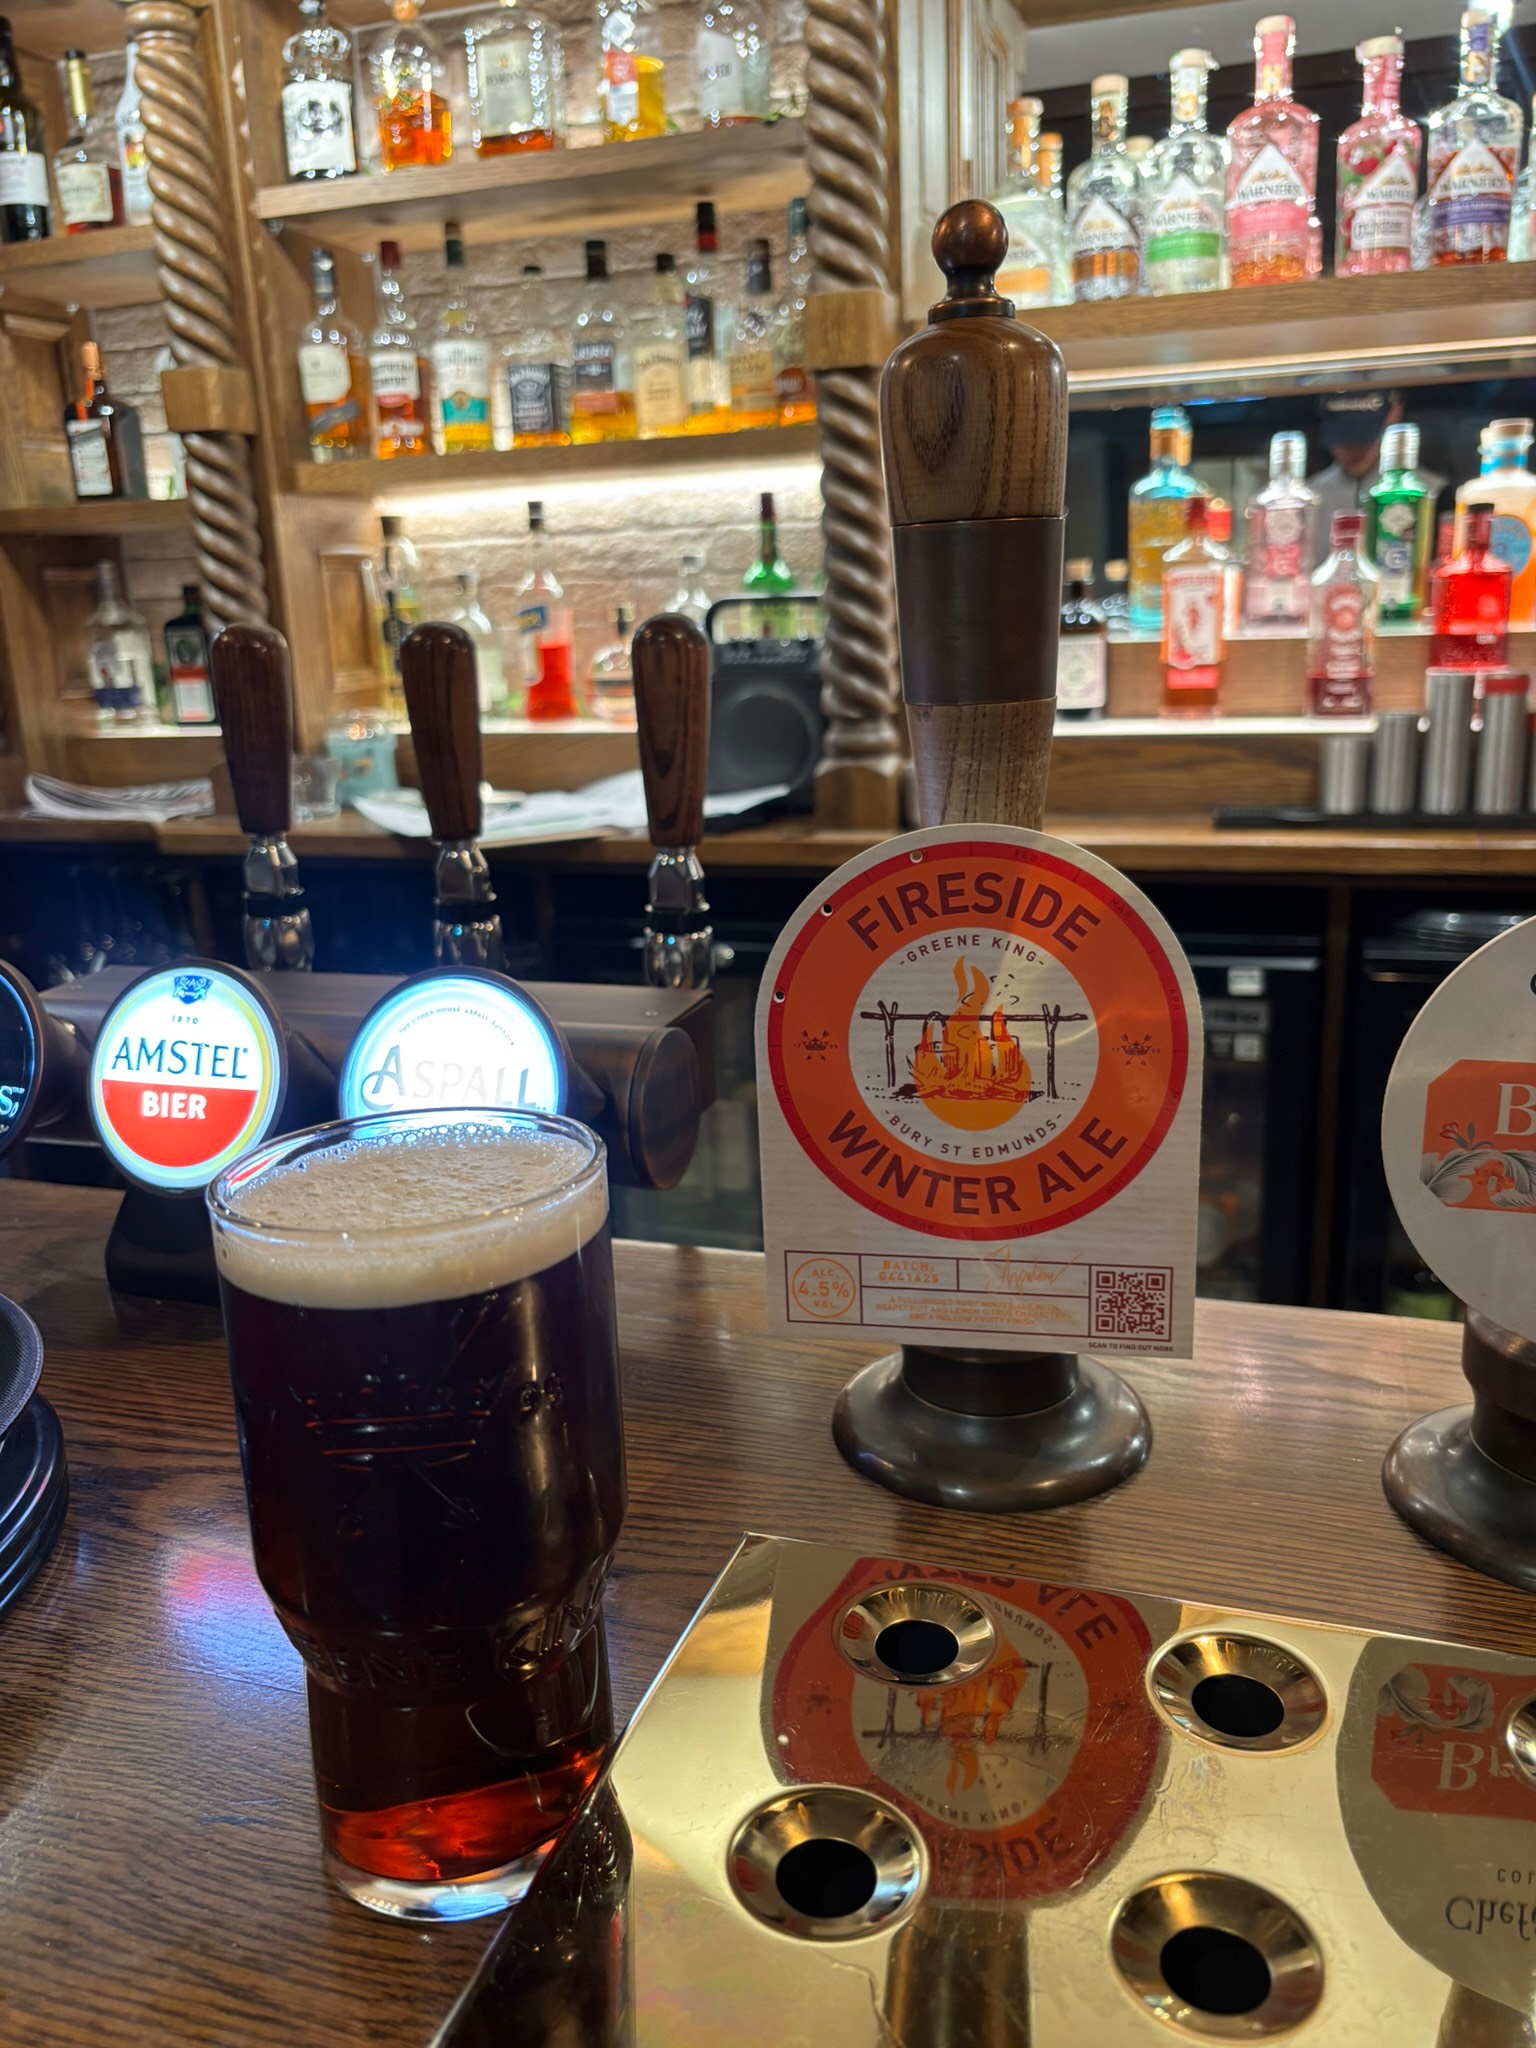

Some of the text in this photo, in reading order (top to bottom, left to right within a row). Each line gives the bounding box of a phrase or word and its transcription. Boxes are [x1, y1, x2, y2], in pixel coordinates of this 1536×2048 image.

[847, 871, 1101, 952] FIRESIDE
[172, 1015, 199, 1025] 1870
[465, 1009, 488, 1021] ASPALL
[112, 1036, 248, 1079] AMSTEL
[361, 1044, 537, 1112] ASPALL
[142, 1091, 207, 1120] BIER
[940, 1143, 962, 1157] ST
[828, 1109, 1128, 1215] WINTER ALE
[812, 1268, 839, 1278] ALC.
[882, 1260, 935, 1271] BATCH:
[798, 1281, 850, 1298] 4.5%
[1088, 1341, 1107, 1349] SCAN
